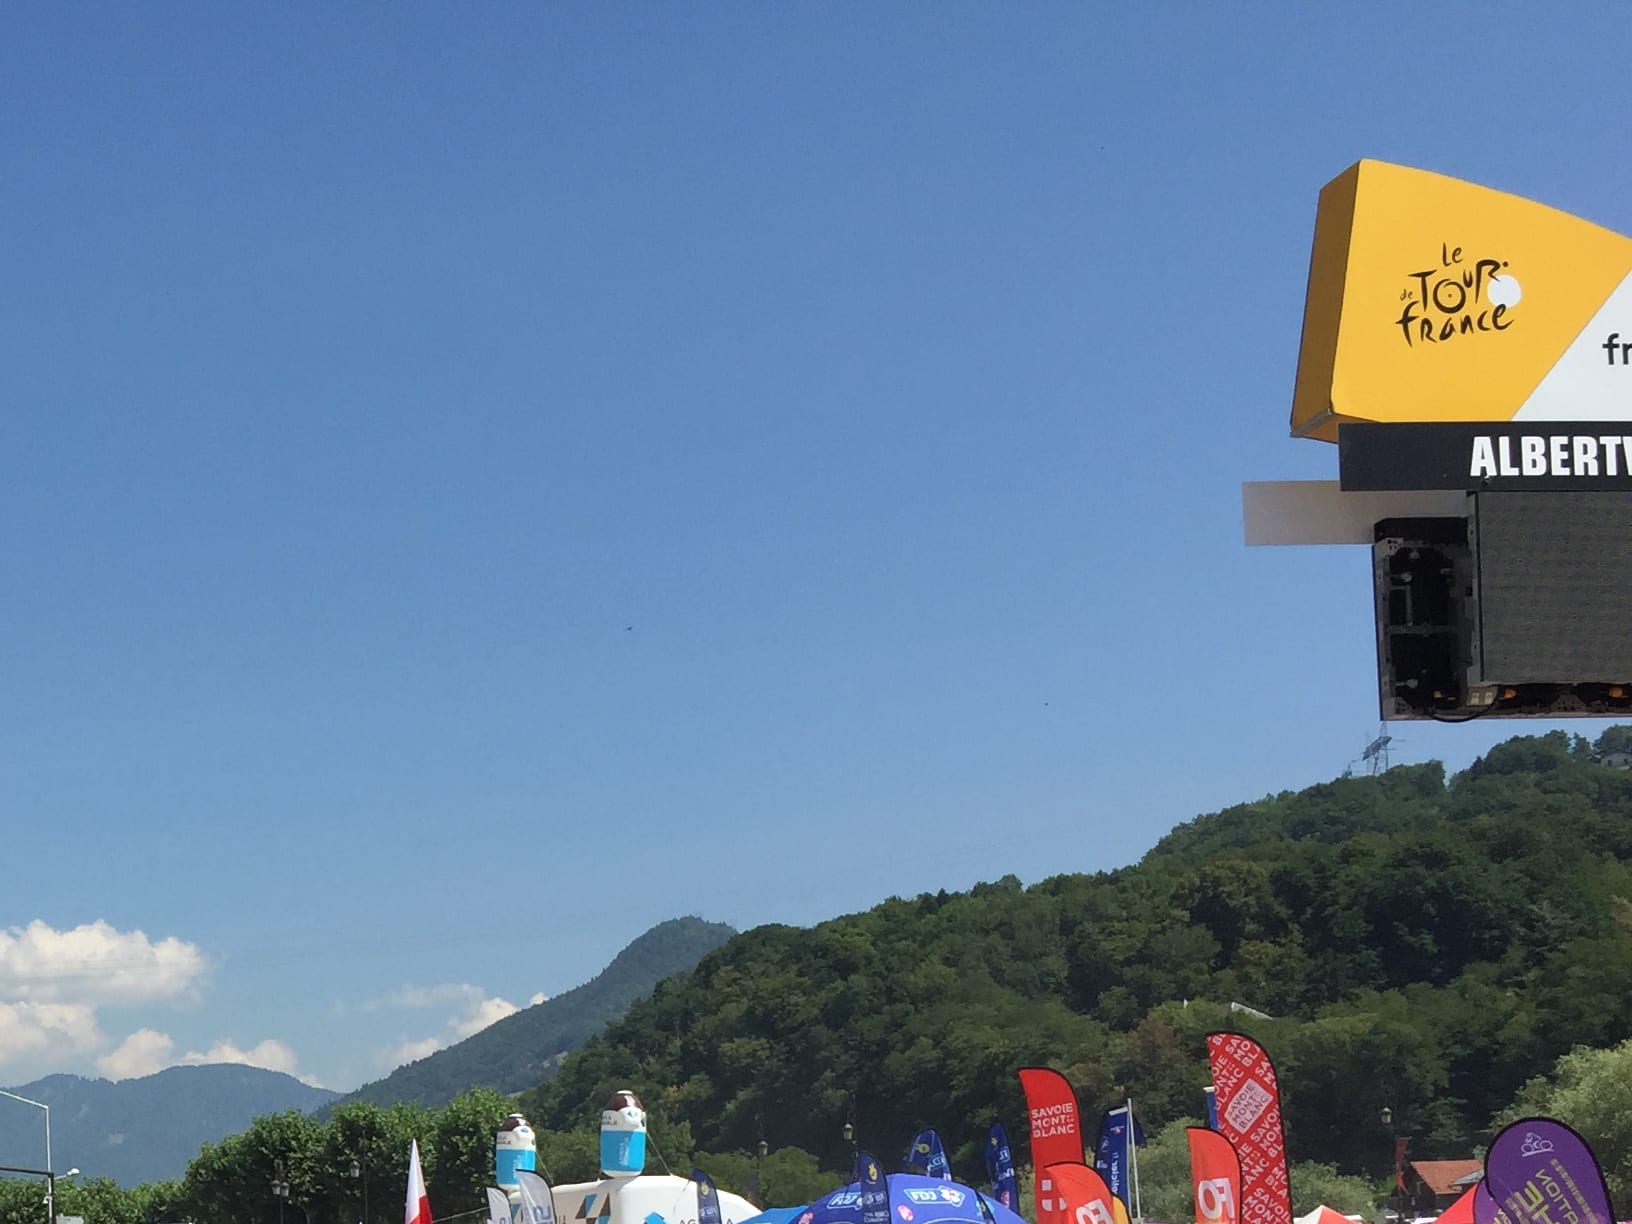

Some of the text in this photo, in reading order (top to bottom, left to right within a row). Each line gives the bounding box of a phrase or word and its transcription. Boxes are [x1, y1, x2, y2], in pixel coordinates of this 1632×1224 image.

[1031, 1102, 1074, 1119] SAVOIE
[1031, 1116, 1067, 1131] MONT
[1033, 1123, 1076, 1138] BLANC
